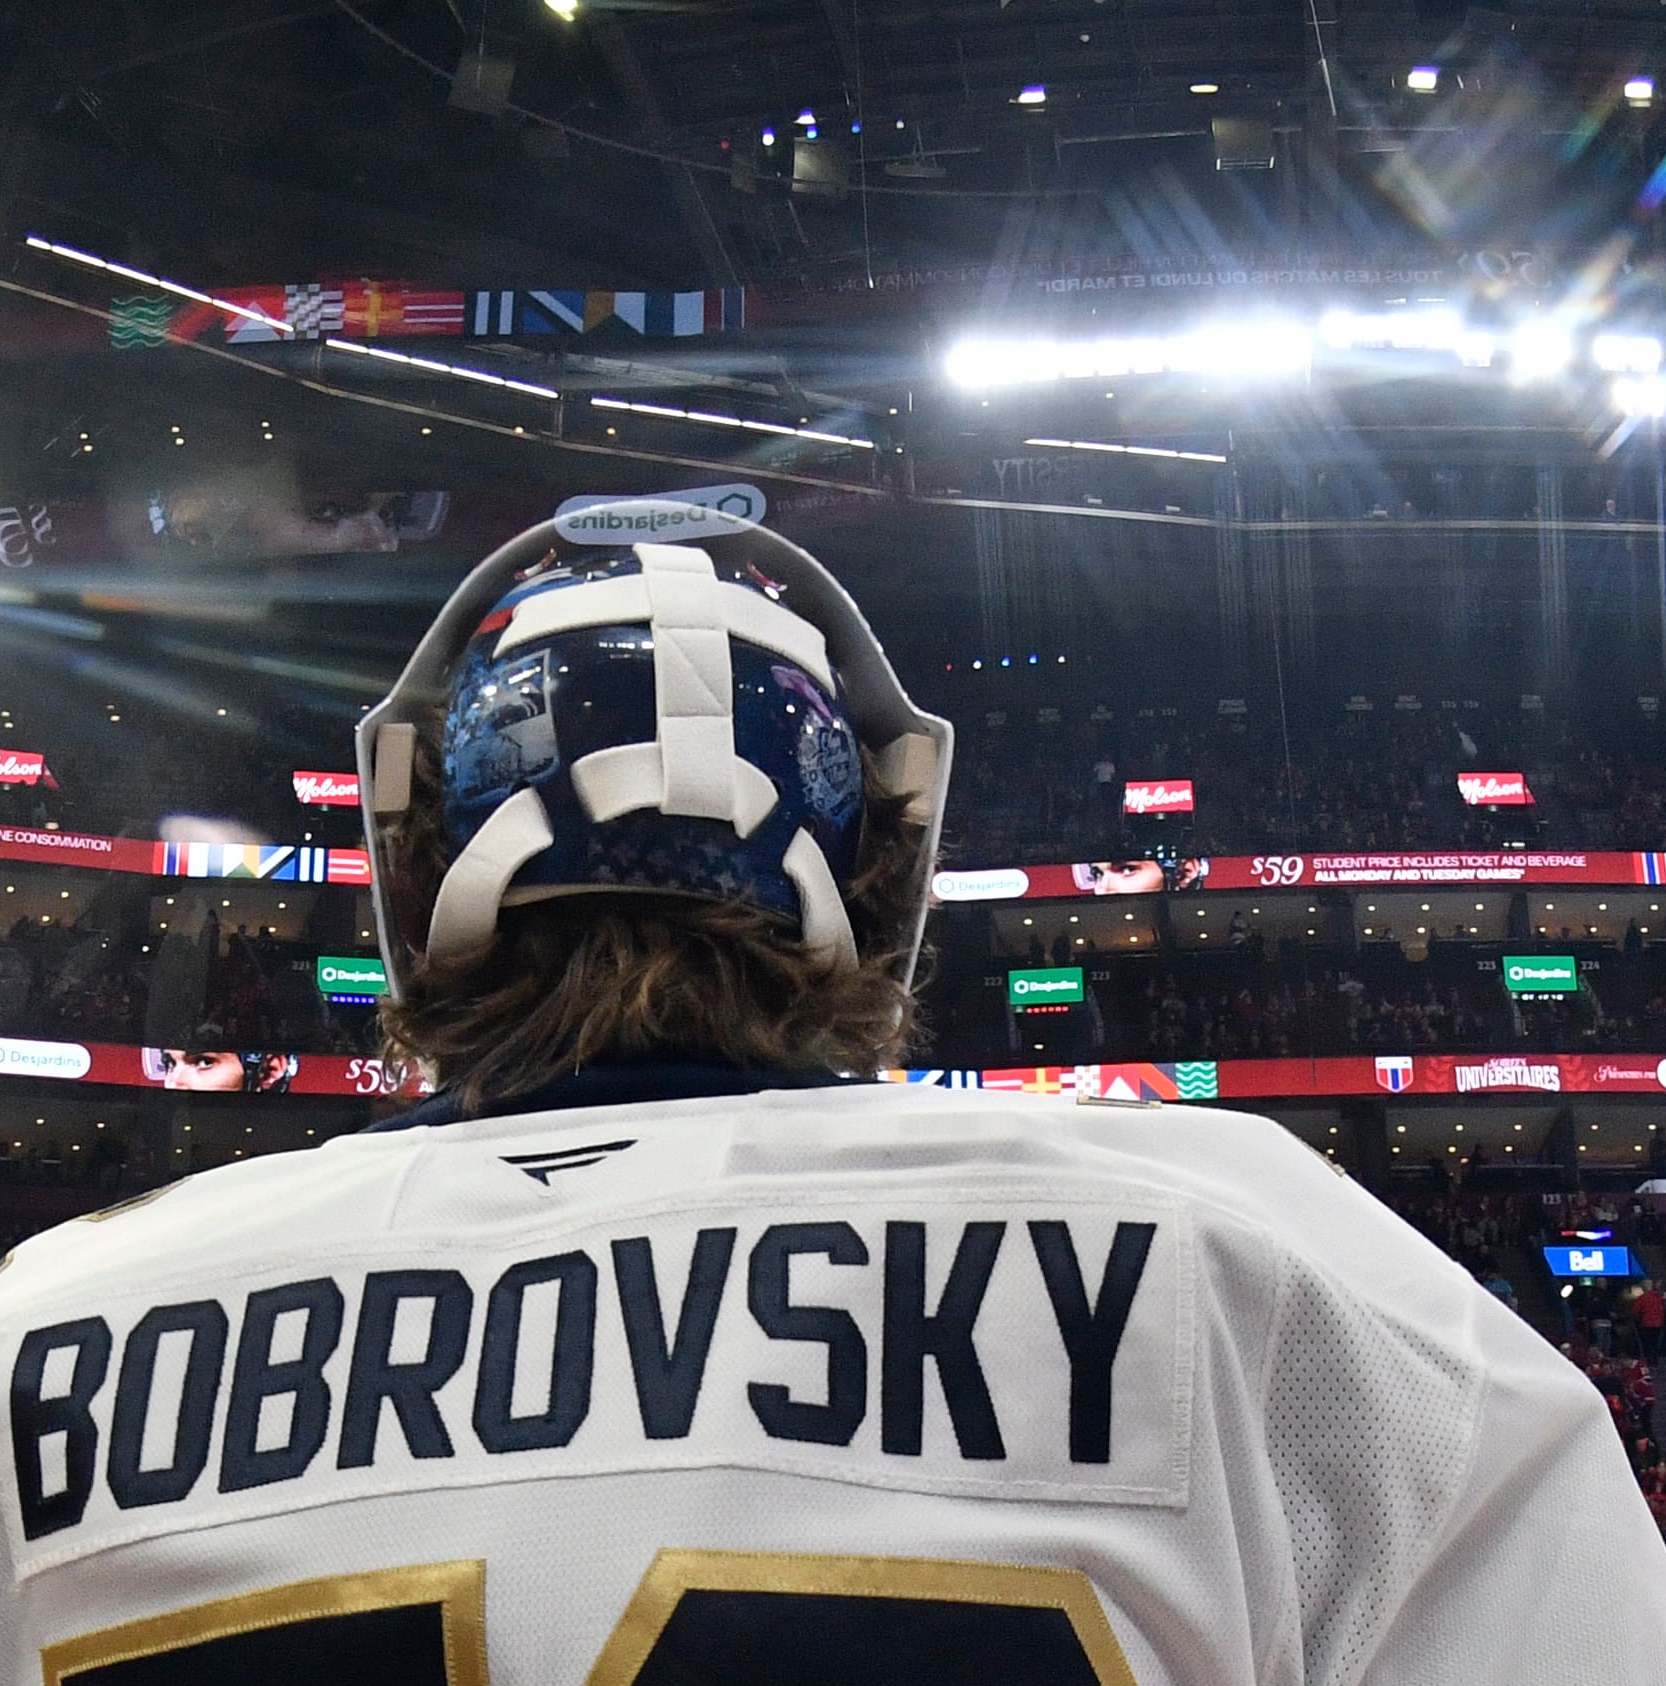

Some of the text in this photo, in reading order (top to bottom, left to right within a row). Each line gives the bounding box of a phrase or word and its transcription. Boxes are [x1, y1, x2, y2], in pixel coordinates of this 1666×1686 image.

[293, 776, 359, 803] Molson
[1126, 786, 1191, 813] Molson
[1458, 778, 1522, 805] Molson
[15, 831, 112, 852] CONSOMMATION
[1251, 855, 1305, 887] $59
[1312, 854, 1587, 870] STUDENT PRICE INCLUDES TICKET AND BEVERAGE
[1314, 869, 1339, 882] ALL
[1392, 868, 1423, 881] AND
[1422, 868, 1476, 880] TUESDAY
[10, 1050, 83, 1070] Desjardins
[1455, 1065, 1561, 1092] UNIVERSITAIRES
[1569, 1250, 1604, 1272] Bell
[10, 1221, 1156, 1542] BOBROVSKY
